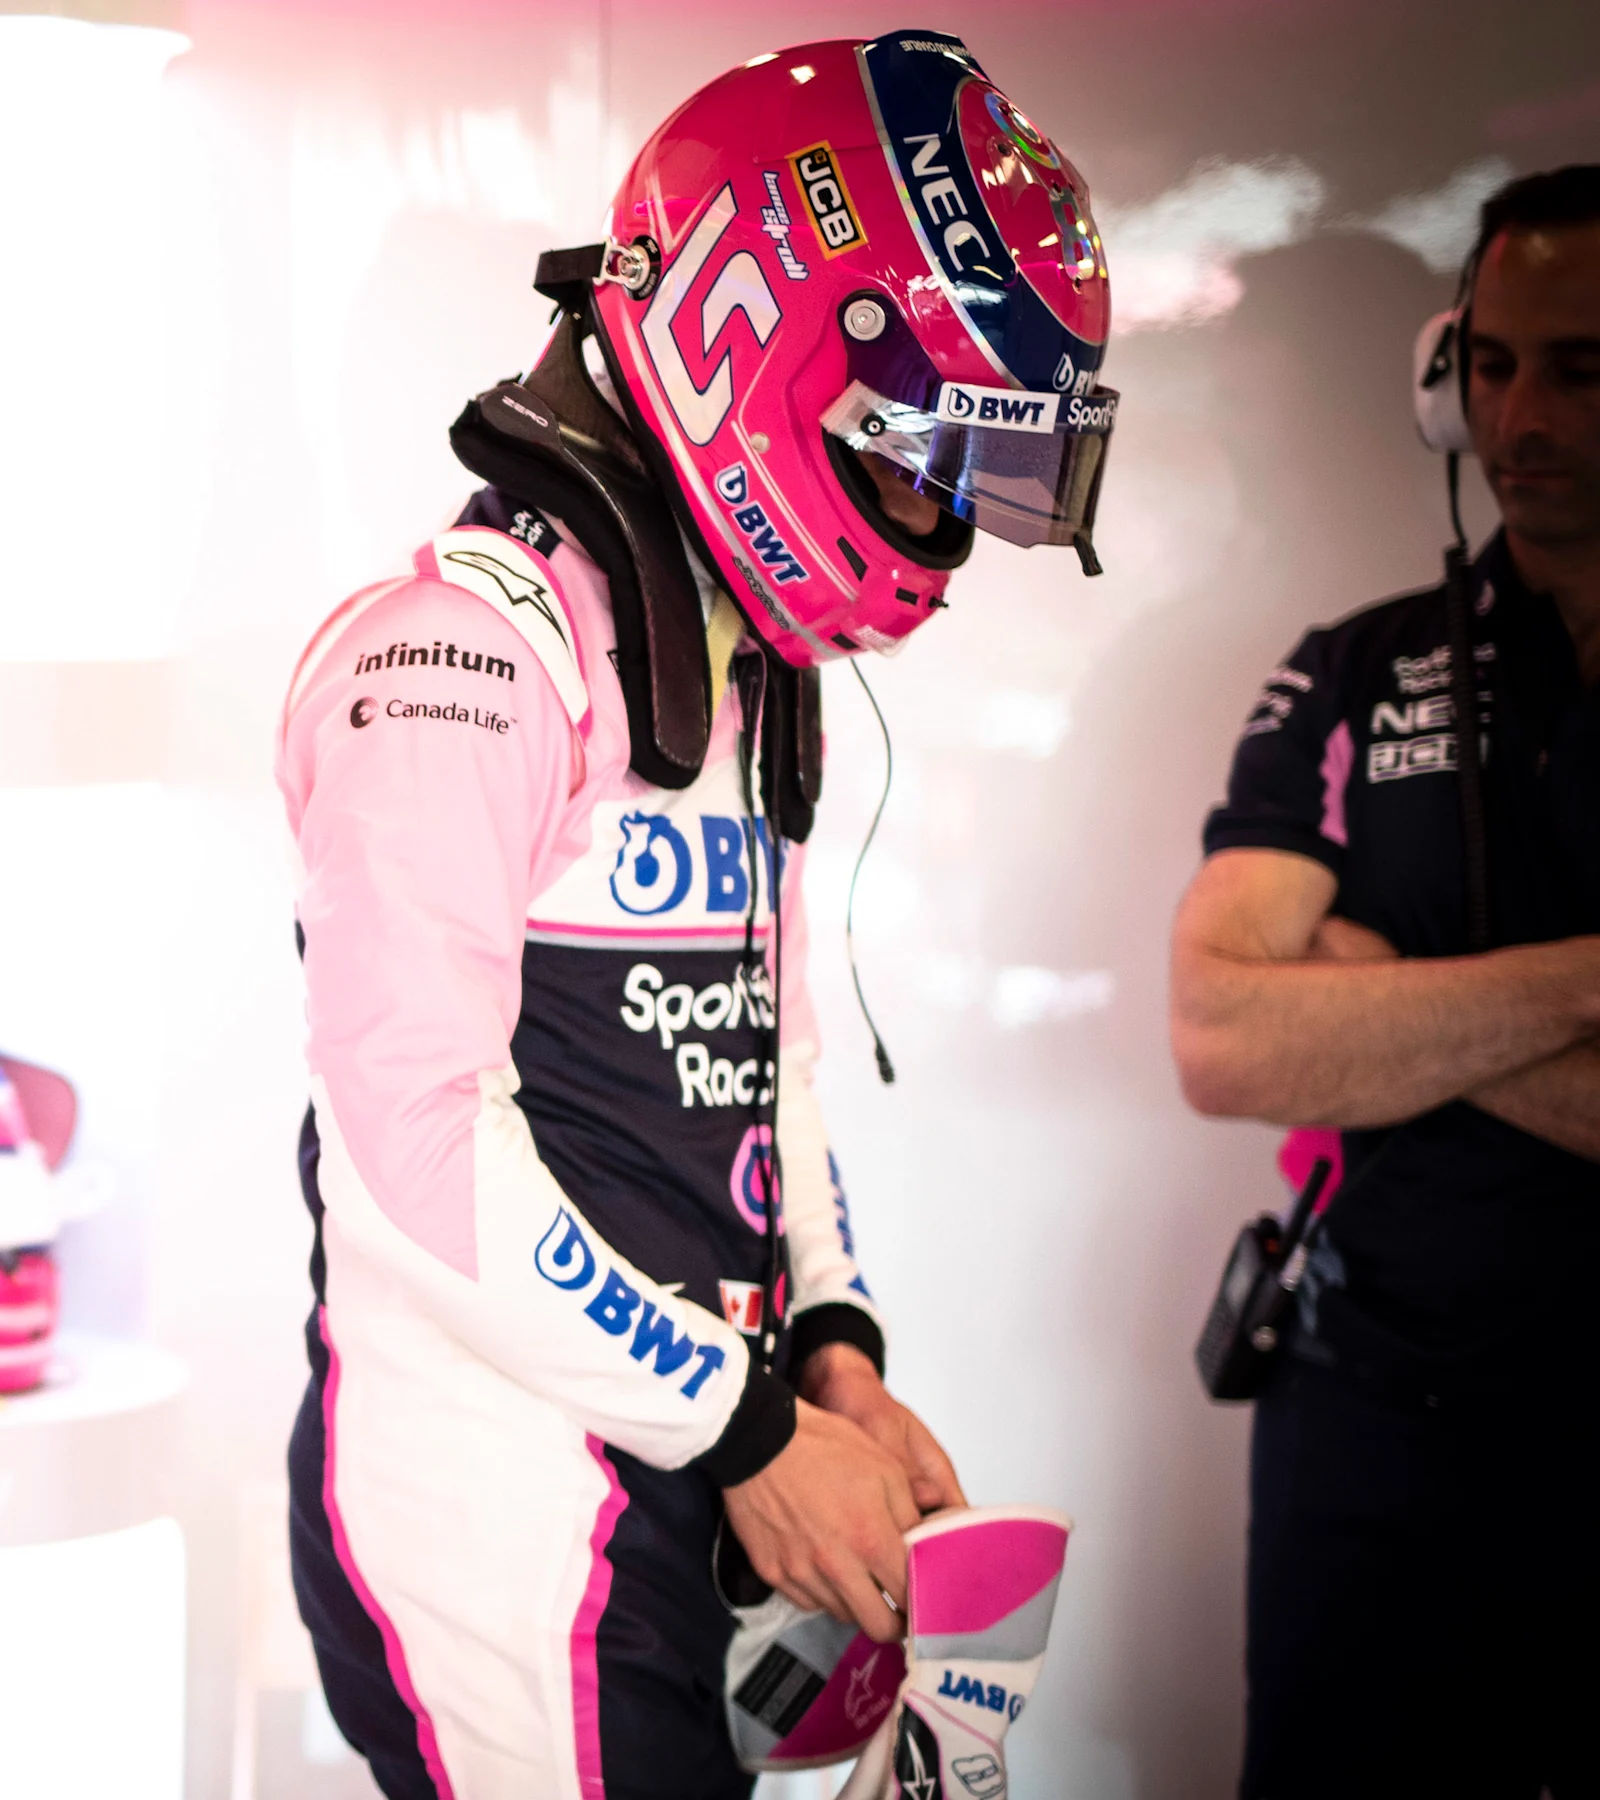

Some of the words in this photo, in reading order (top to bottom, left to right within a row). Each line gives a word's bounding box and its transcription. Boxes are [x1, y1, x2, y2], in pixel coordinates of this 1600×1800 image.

[800, 156, 855, 247] JCB
[903, 133, 991, 272] NEC
[978, 396, 1046, 427] BWT
[732, 500, 811, 586] BWT
[354, 641, 516, 683] infinitum
[385, 699, 470, 724] Canada
[1370, 694, 1457, 735] NE
[584, 1265, 726, 1401] BWT
[937, 1668, 1008, 1714] BWT
